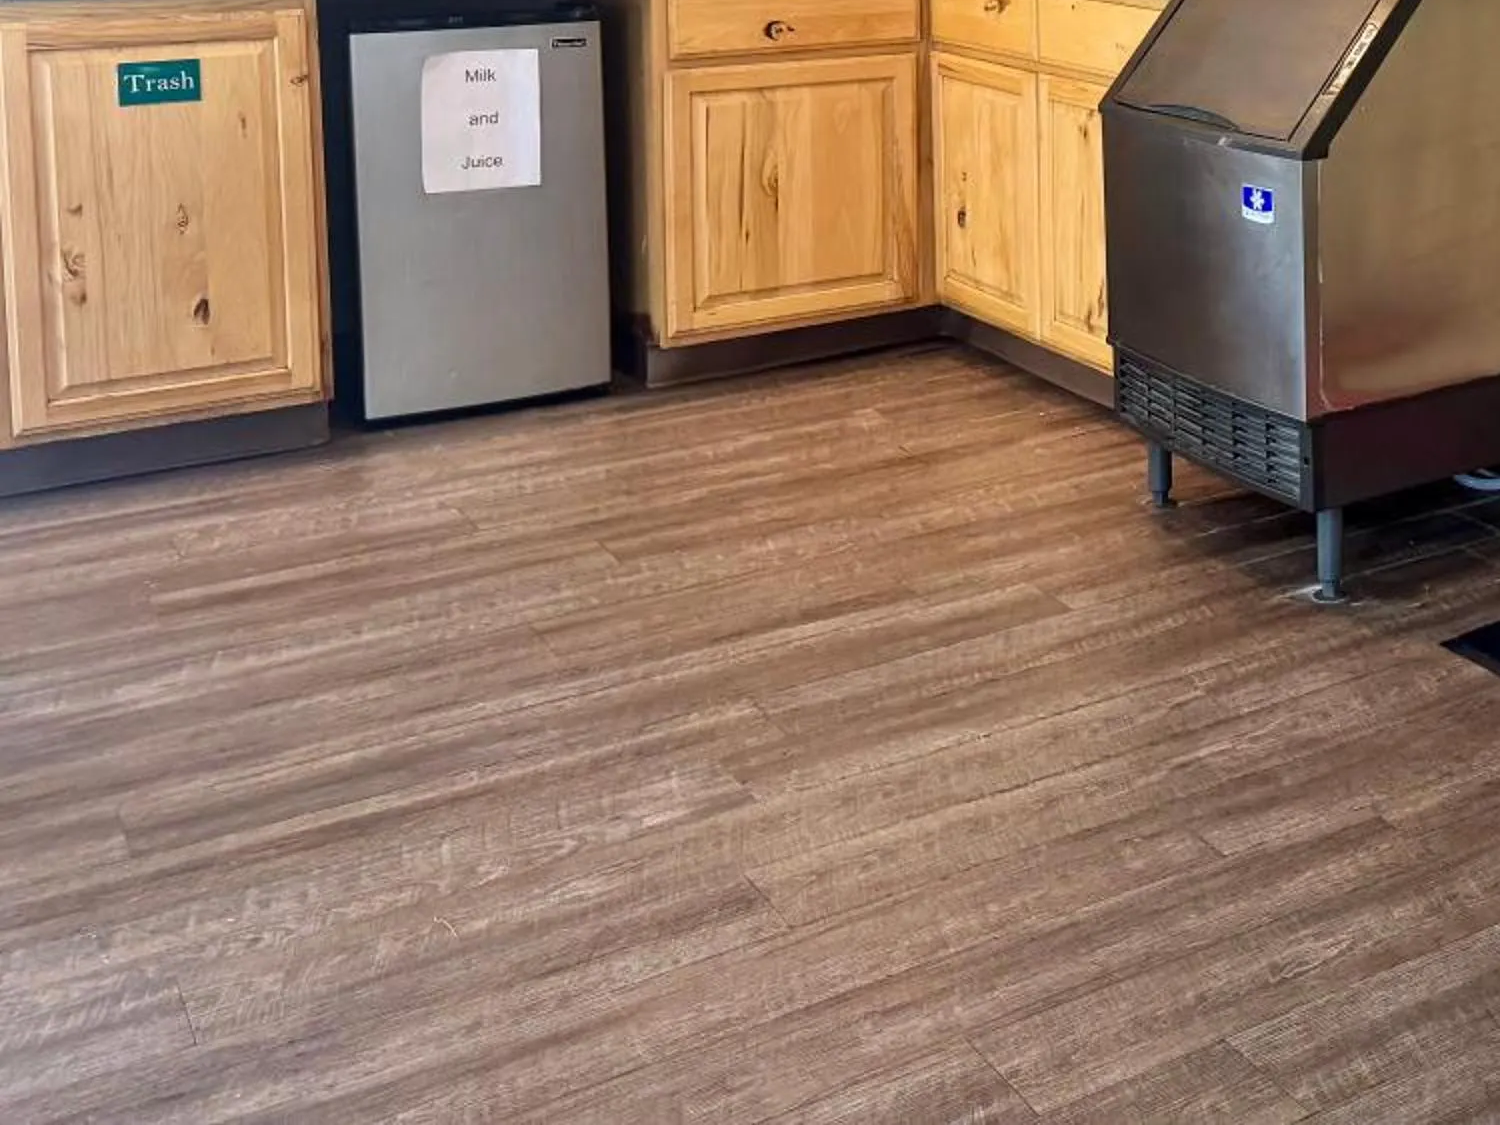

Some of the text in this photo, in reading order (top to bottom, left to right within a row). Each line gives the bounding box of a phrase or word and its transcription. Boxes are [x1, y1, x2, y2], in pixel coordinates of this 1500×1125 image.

[123, 70, 195, 94] Trash
[465, 68, 497, 83] Milk
[468, 110, 500, 126] and
[461, 154, 504, 170] Juice
